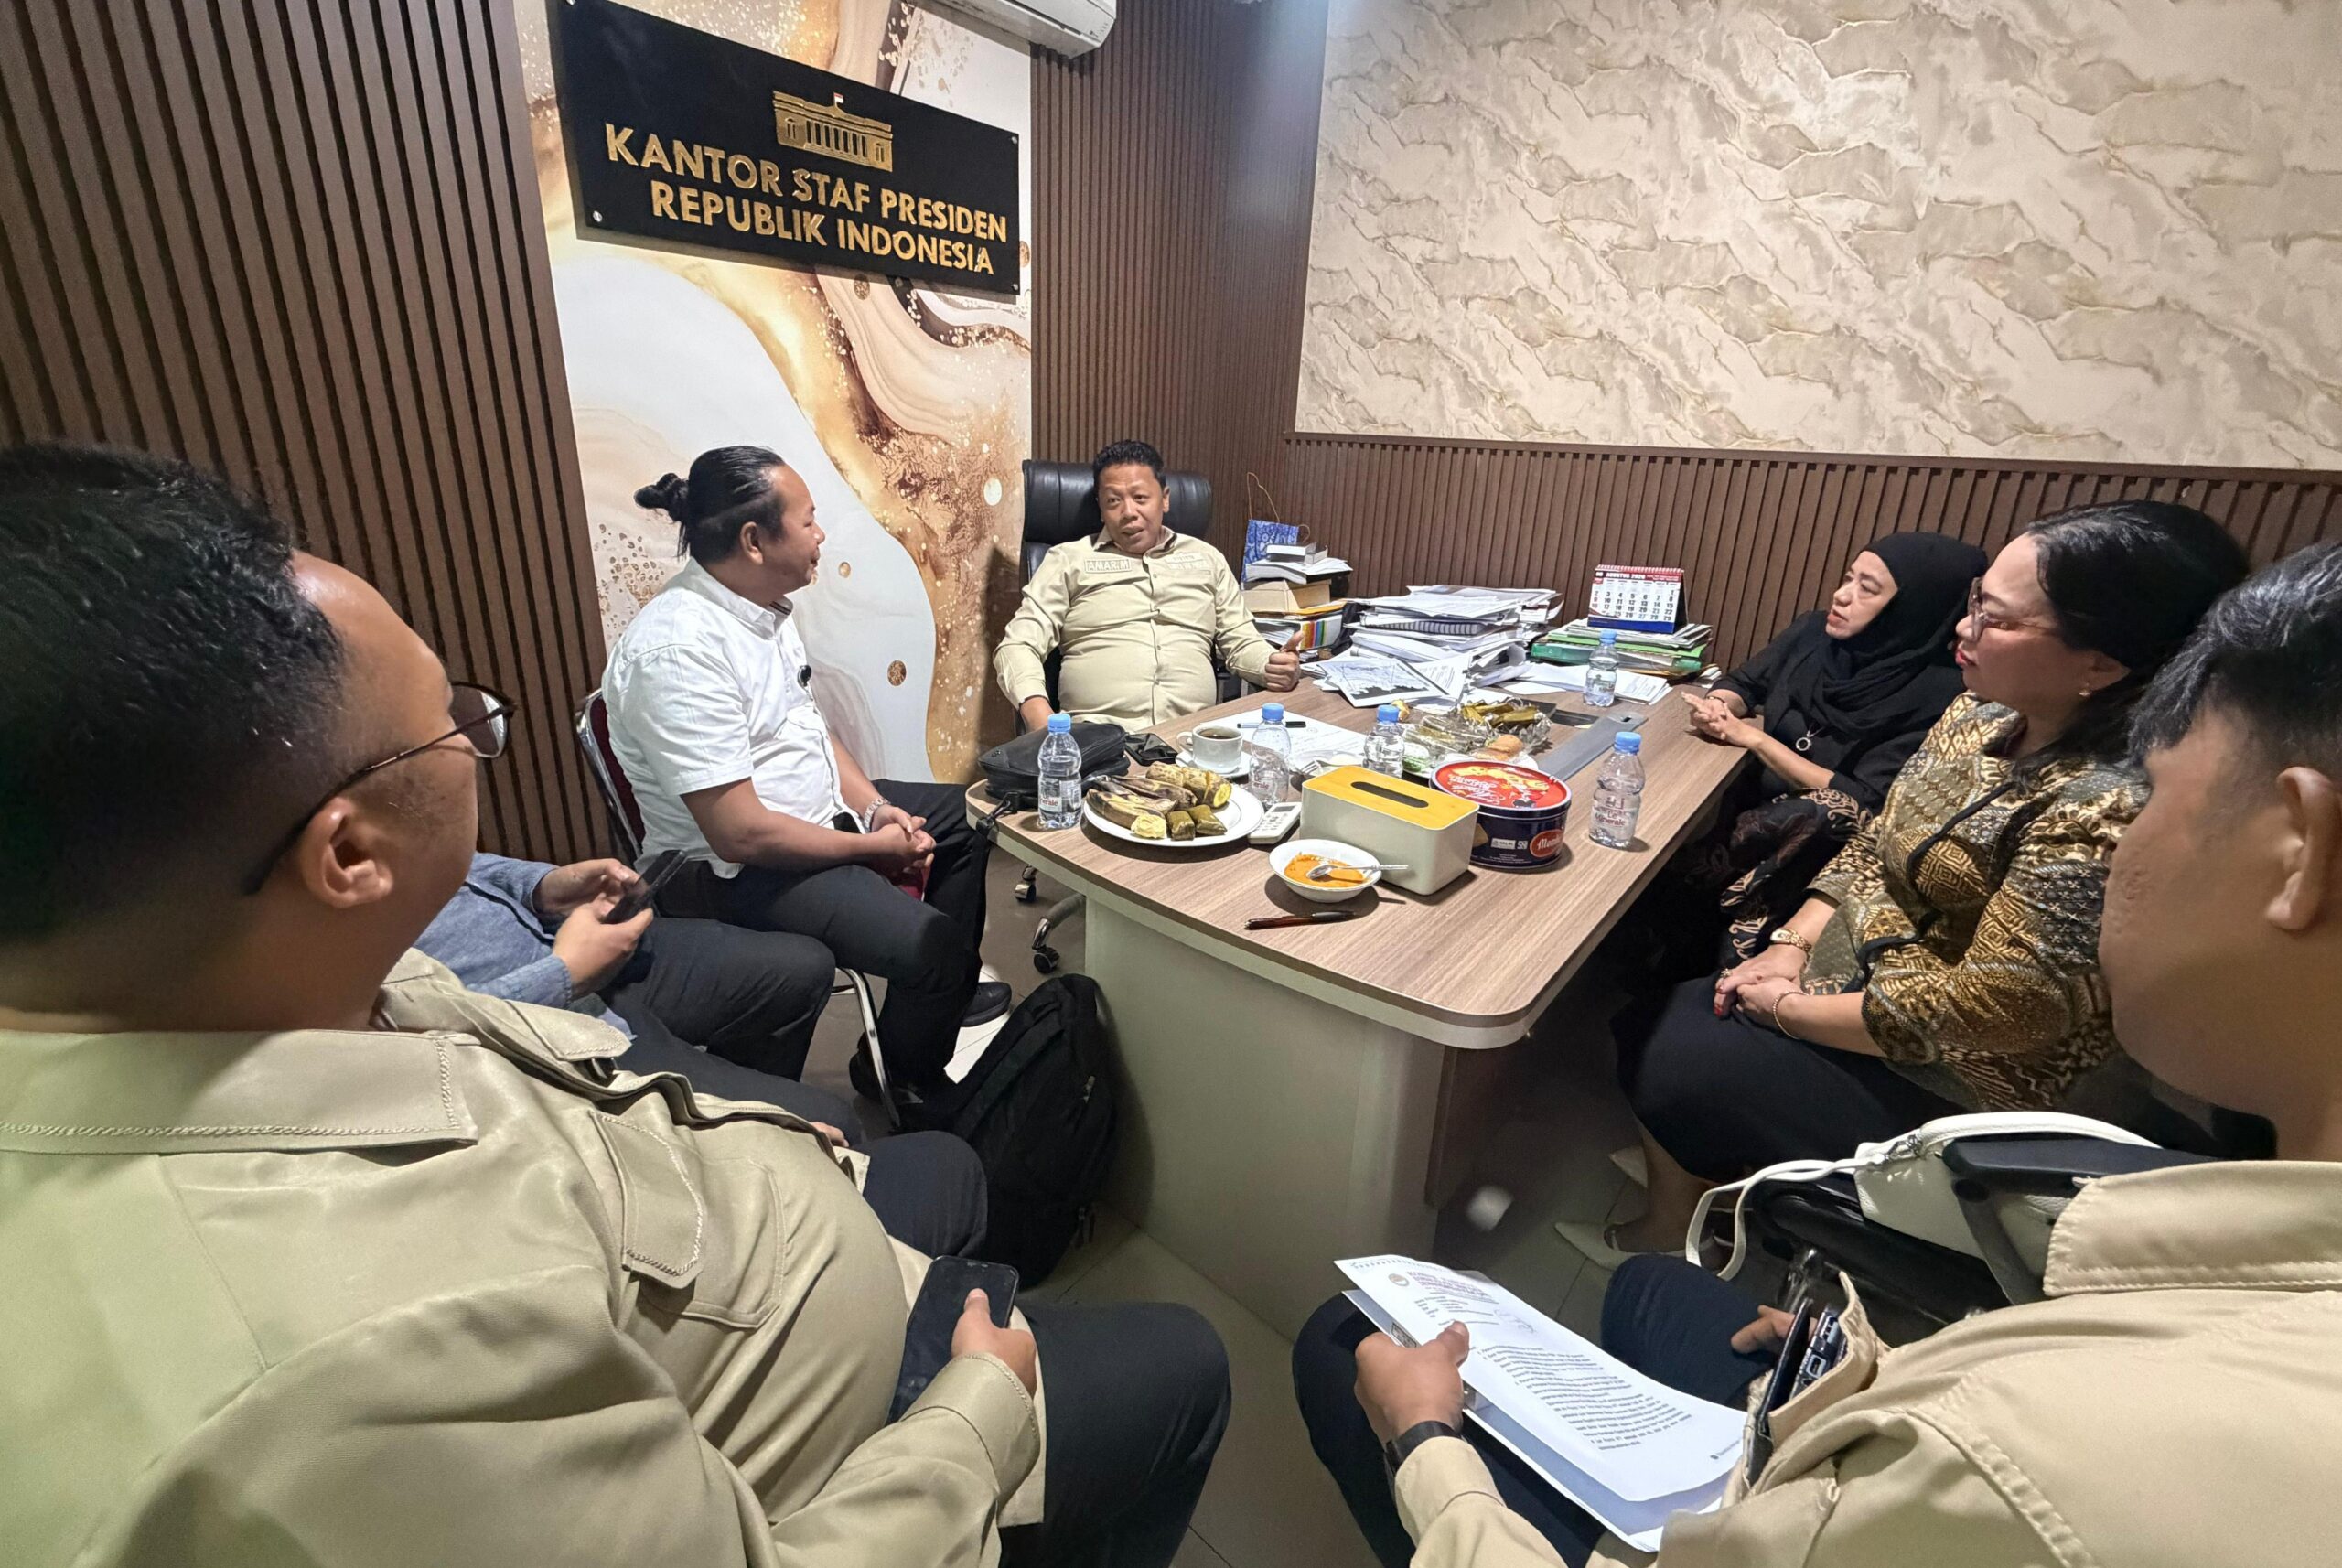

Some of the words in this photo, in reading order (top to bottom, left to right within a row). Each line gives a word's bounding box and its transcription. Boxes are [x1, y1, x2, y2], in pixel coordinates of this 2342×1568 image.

[606, 123, 783, 197] KANTOR
[792, 168, 870, 213] STAF
[881, 188, 1007, 242] PRESIDEN
[651, 179, 828, 246] REPUBLIK
[836, 218, 994, 275] INDONESIA
[1595, 812, 1626, 826] Minerale
